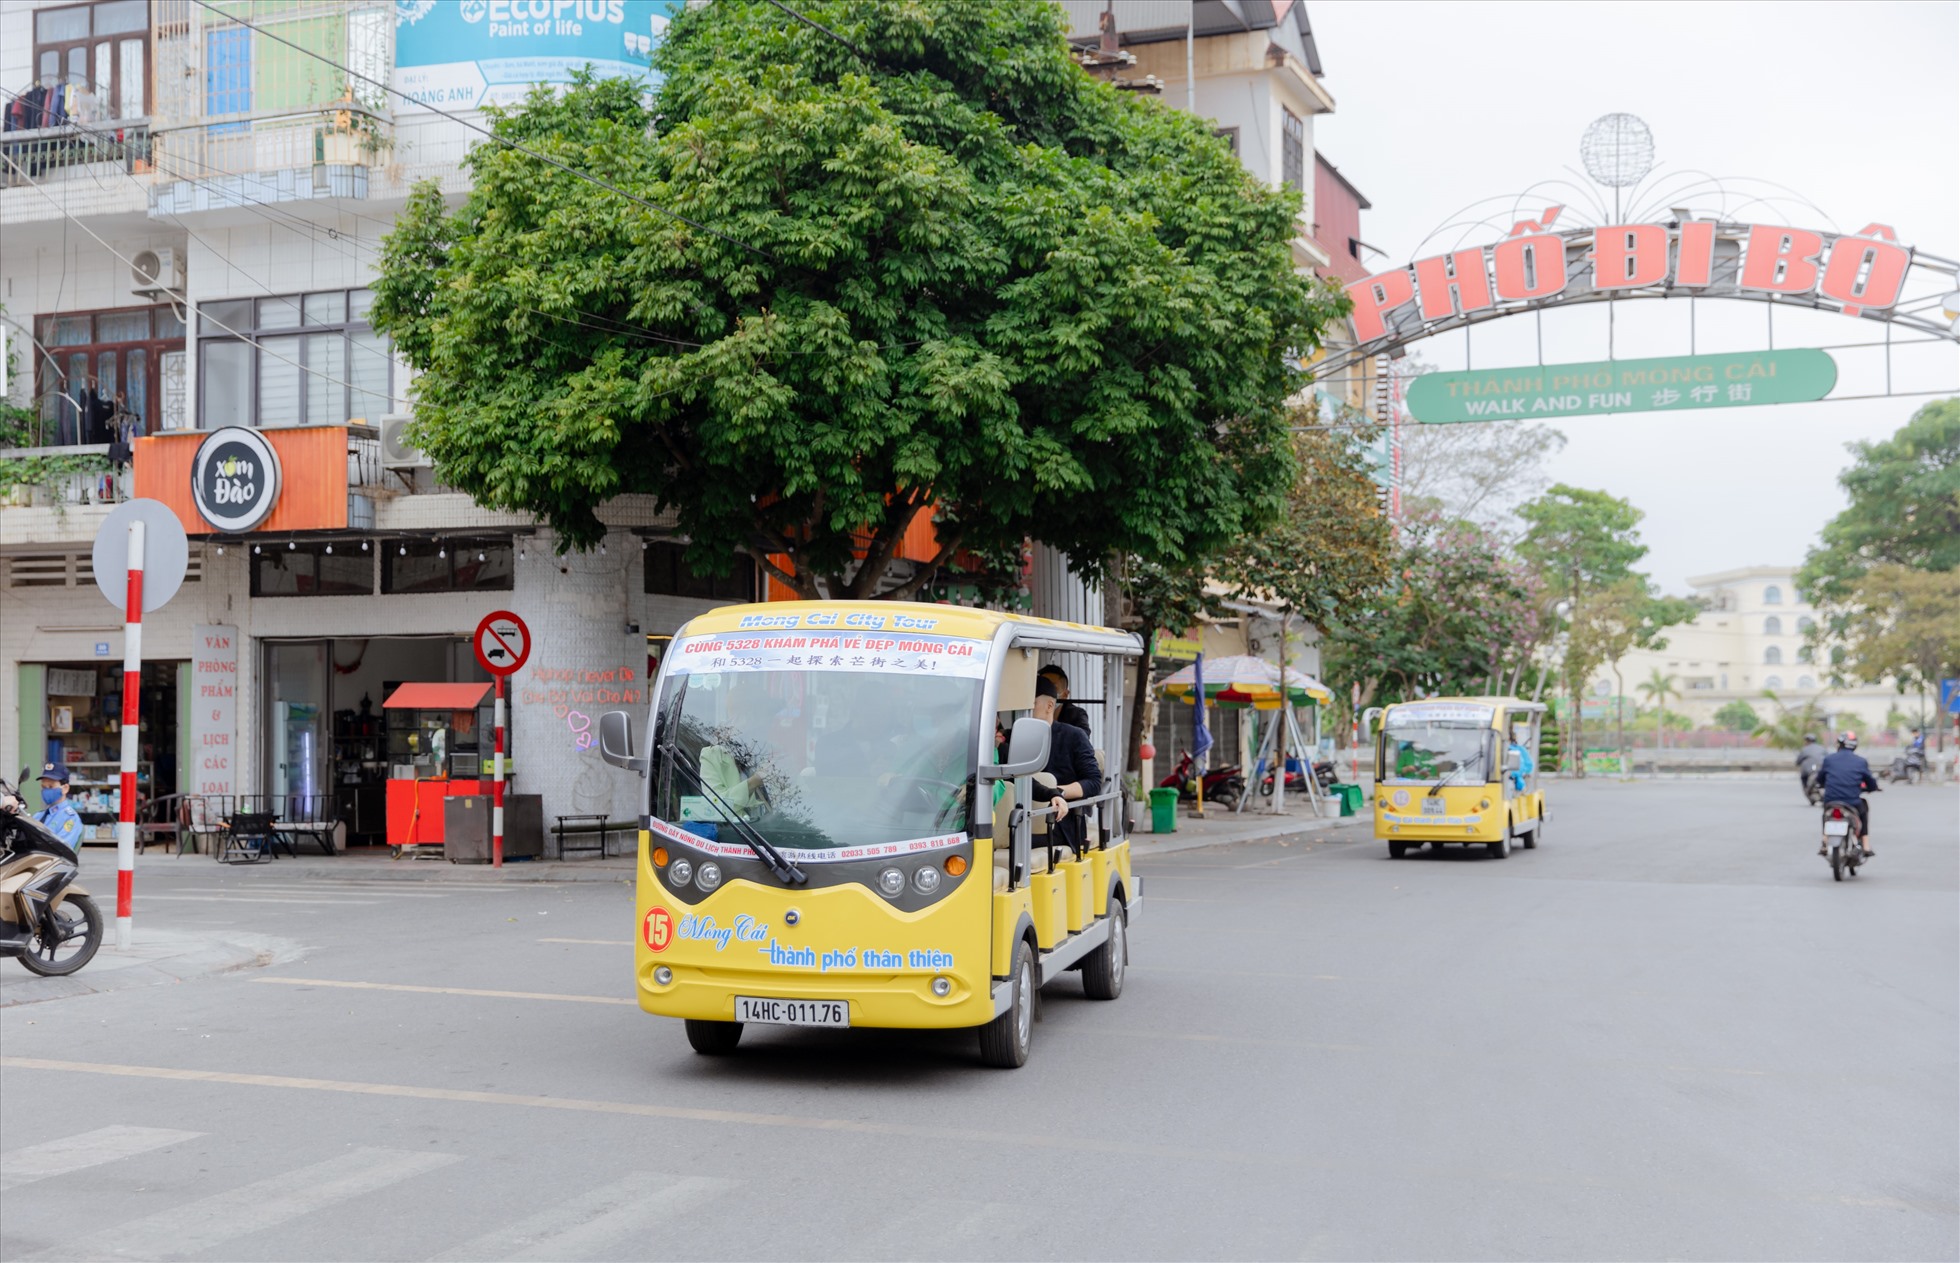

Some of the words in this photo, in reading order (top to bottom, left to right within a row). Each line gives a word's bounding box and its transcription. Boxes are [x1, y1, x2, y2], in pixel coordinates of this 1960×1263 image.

[489, 21, 530, 38] Paint
[534, 20, 551, 35] of
[555, 19, 582, 36] life
[402, 85, 445, 106] HOÀNG
[448, 86, 473, 102] ANH
[1346, 203, 1568, 345] PHỐ
[1740, 222, 1912, 317] BỘ
[1447, 375, 1543, 398] THÀNH
[1622, 362, 1714, 387] MÓNG
[1725, 358, 1777, 381] CÁI
[1465, 398, 1525, 416] WALK
[1531, 395, 1582, 412] AND
[1589, 391, 1632, 409] FUN
[1651, 382, 1753, 407] 步行街
[213, 477, 255, 505] Đào
[739, 614, 800, 629] Mong
[806, 612, 838, 626] Cai
[846, 612, 886, 630] City
[893, 614, 938, 630] Tour
[684, 639, 722, 654] CÙNG
[725, 638, 760, 651] 5328
[763, 635, 805, 649] KHÁM
[809, 635, 839, 649] PHÁ
[865, 639, 894, 653] ĐẸP
[898, 639, 943, 655] MÓNG
[947, 643, 973, 657] CÁI
[198, 658, 236, 673] PHÒNG
[211, 709, 221, 721] &
[203, 733, 229, 748] LỊCH
[204, 754, 228, 769] CÁC
[696, 839, 705, 848] DU
[705, 843, 719, 853] LỊCH
[721, 845, 742, 855] THÀNH
[866, 847, 880, 856] 505
[883, 845, 897, 854] 789
[646, 913, 668, 945] 15
[677, 913, 734, 953] Móng
[733, 914, 769, 942] Cái
[758, 938, 815, 967] thành
[821, 947, 857, 972] phố
[863, 949, 902, 968] thân
[908, 948, 953, 972] thiện
[742, 1000, 842, 1023] 14HC-011.76
